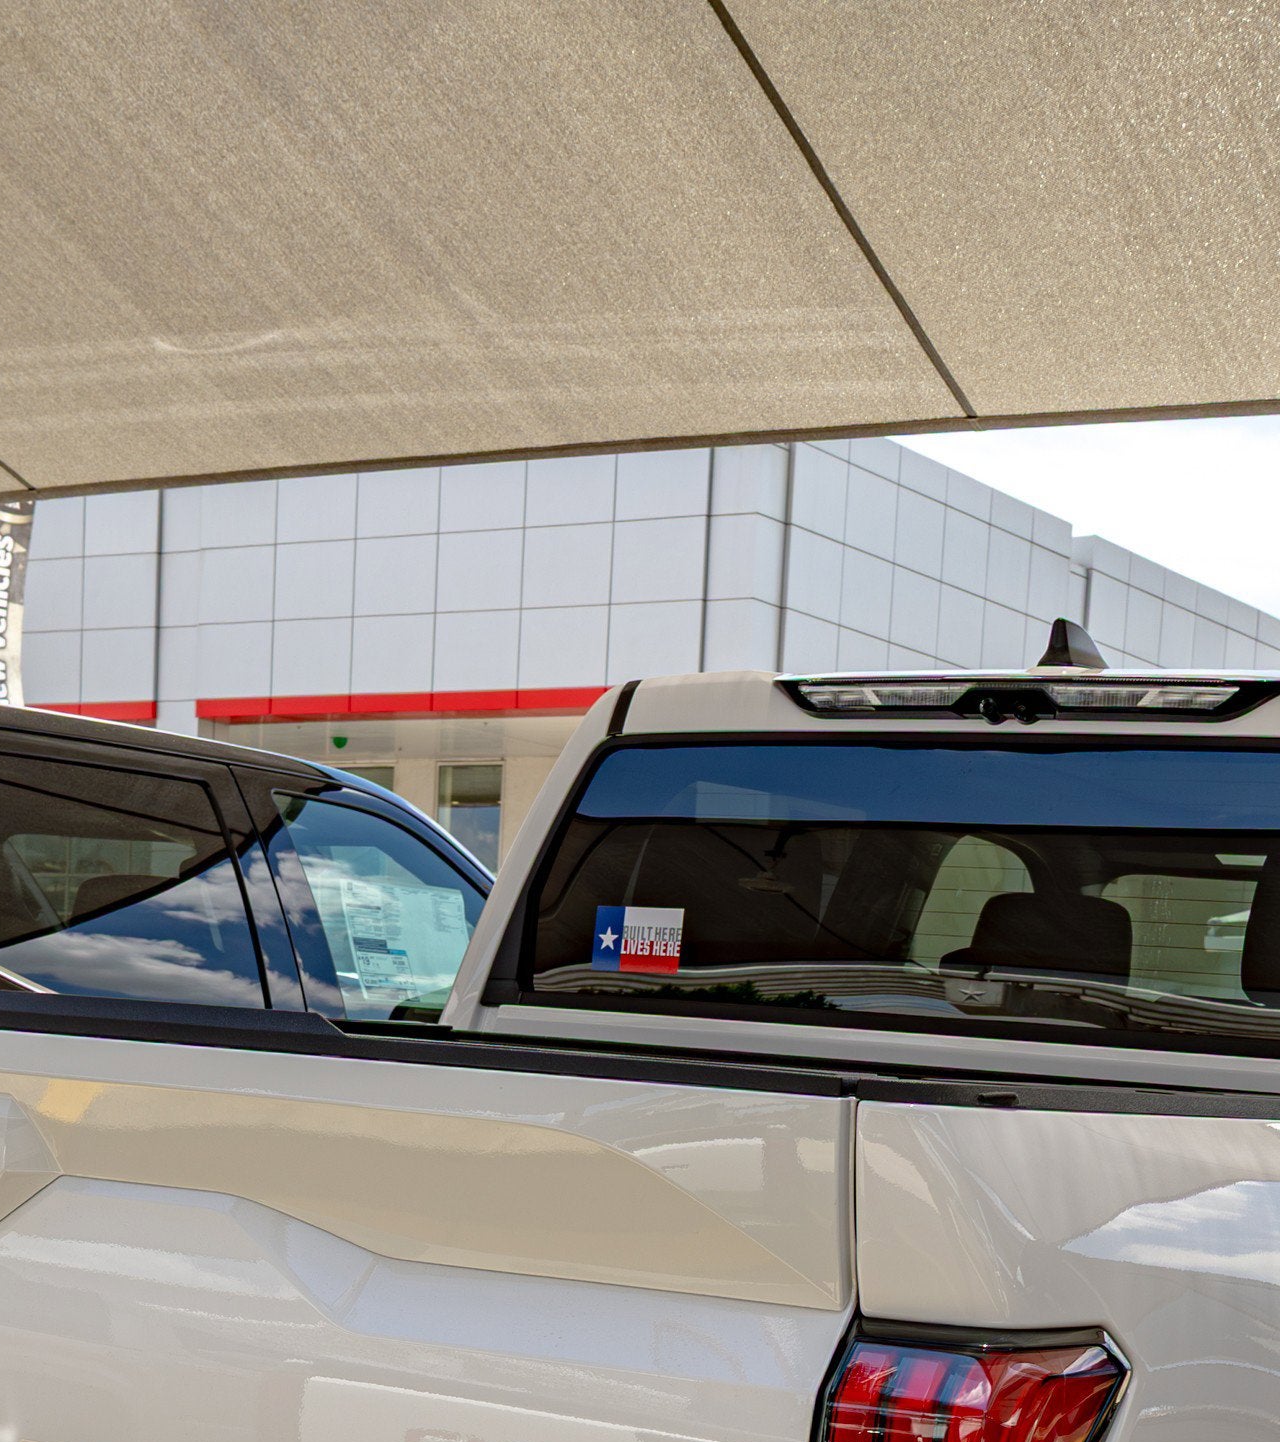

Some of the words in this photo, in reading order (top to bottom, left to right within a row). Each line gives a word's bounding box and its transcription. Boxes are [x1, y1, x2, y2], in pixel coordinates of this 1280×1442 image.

[623, 925, 654, 941] BUILT
[655, 927, 682, 942] HERE
[620, 938, 651, 956] LIVES
[652, 940, 681, 957] HERE
